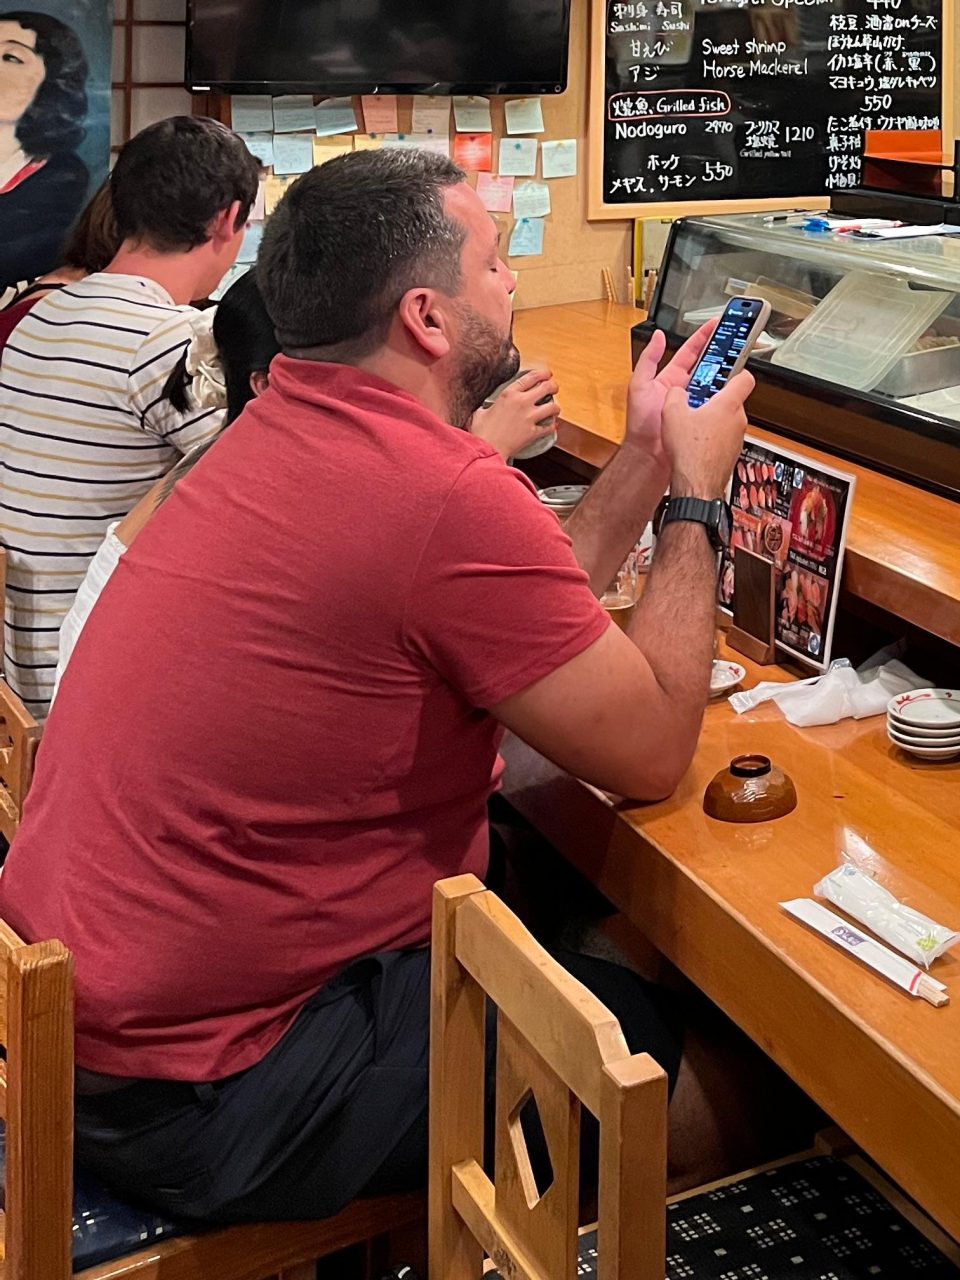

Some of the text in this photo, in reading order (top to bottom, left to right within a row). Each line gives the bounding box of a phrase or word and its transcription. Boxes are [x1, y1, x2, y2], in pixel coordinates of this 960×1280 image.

[661, 20, 690, 31] Sushi
[630, 38, 674, 58] 甘えび
[702, 38, 740, 55] Sweet
[629, 64, 661, 83] アジ
[703, 58, 808, 79] Horse Mackerel
[656, 97, 696, 113] Grilled
[698, 96, 727, 112] fish
[860, 94, 893, 111] 550
[615, 122, 688, 139] Nodoguro
[785, 126, 815, 143] 1210
[647, 154, 681, 171] ホッケ
